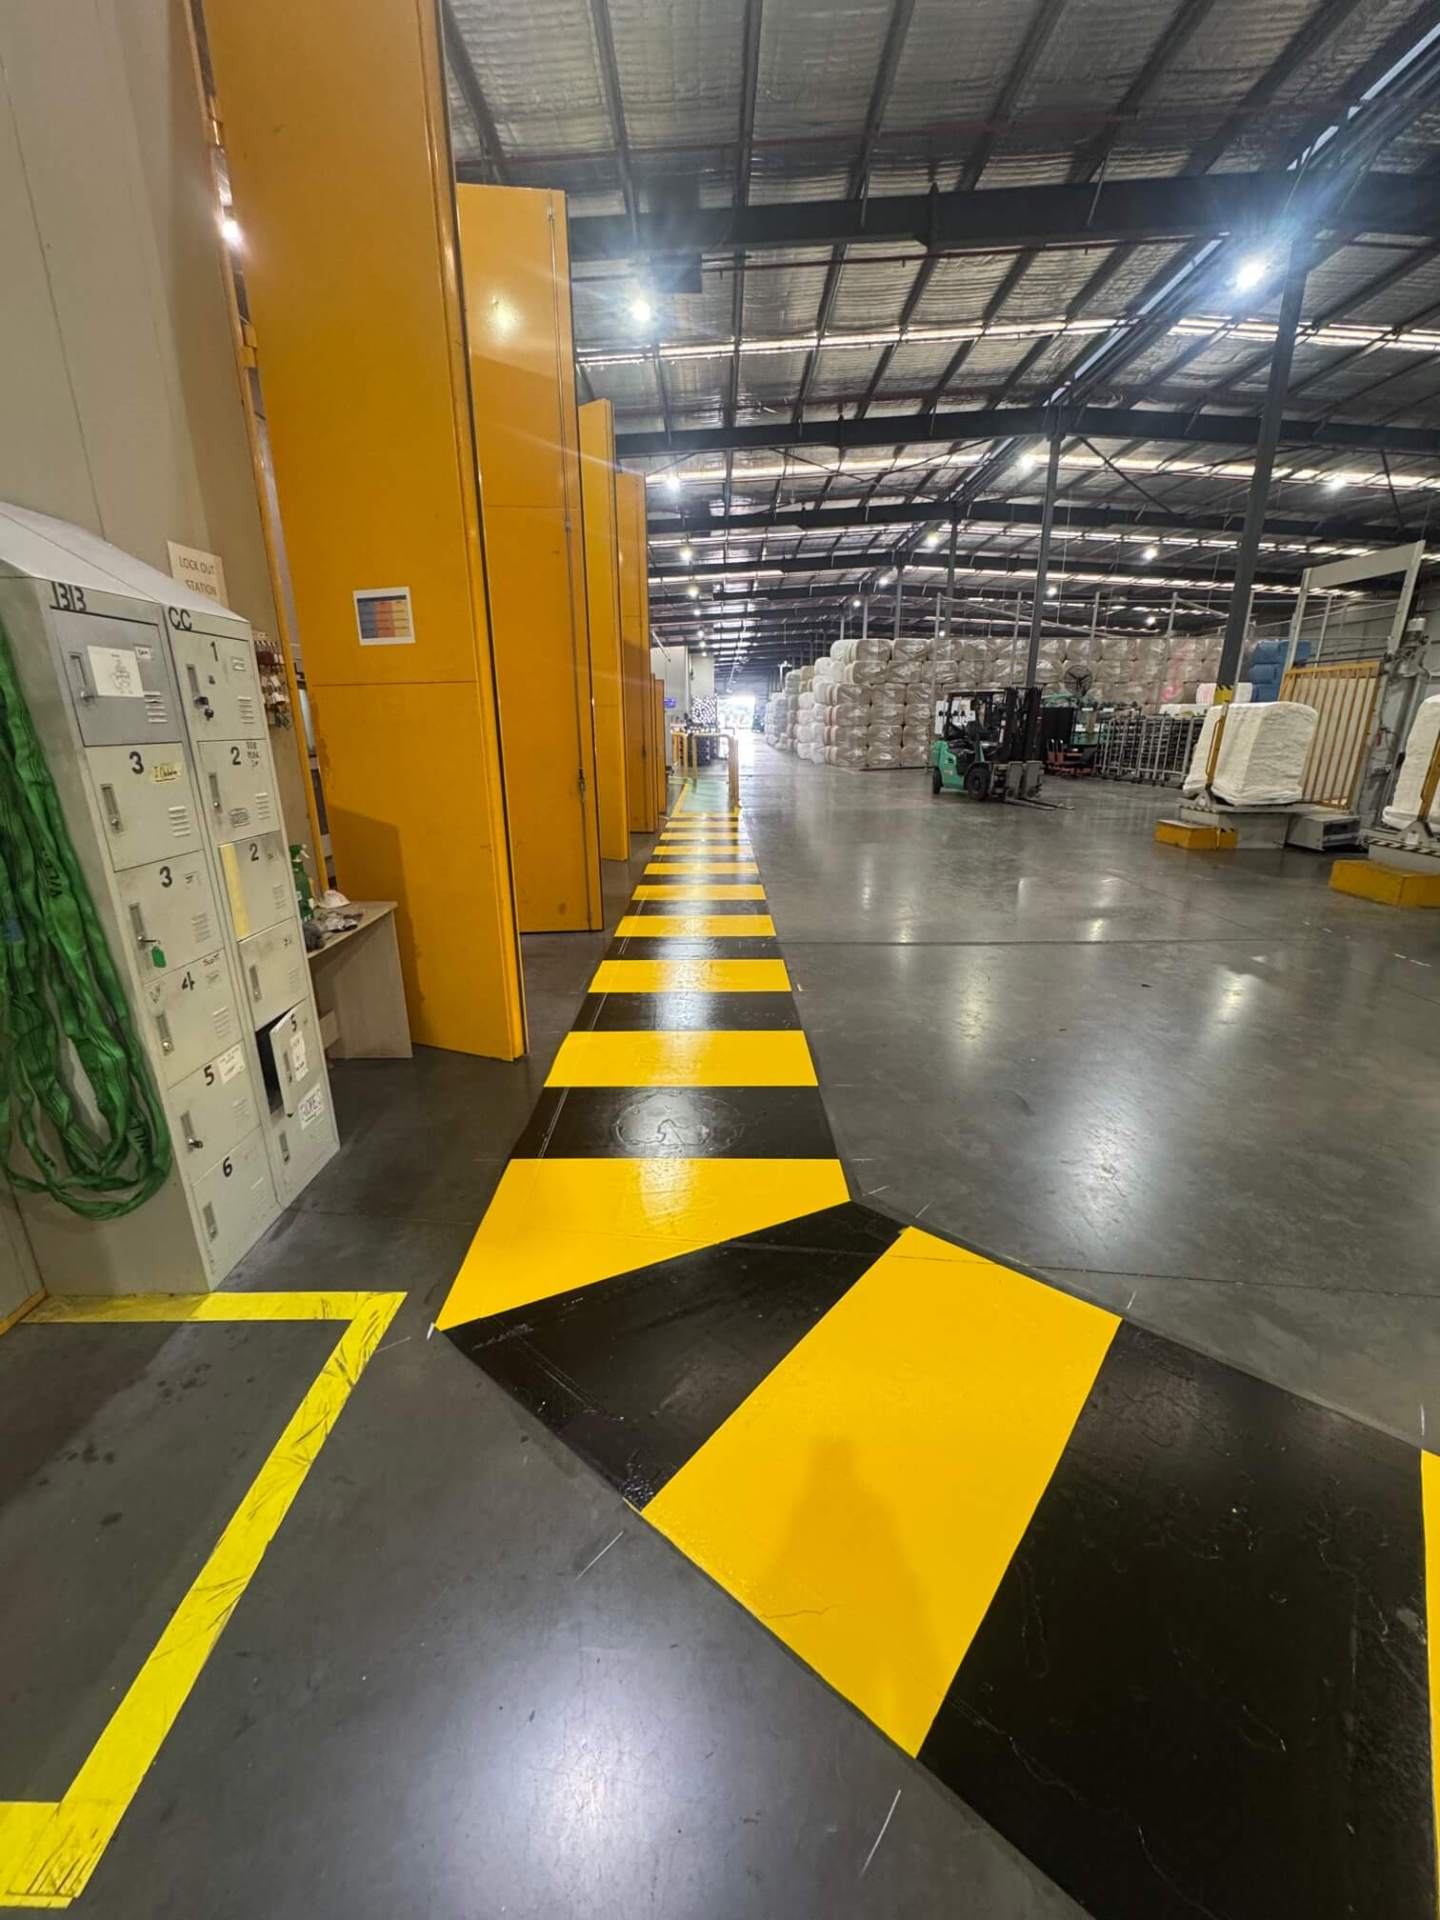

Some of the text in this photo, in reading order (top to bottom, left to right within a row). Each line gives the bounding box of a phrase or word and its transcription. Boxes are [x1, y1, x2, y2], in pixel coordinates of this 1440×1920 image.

[178, 555, 215, 575] LOCK OUT
[50, 581, 87, 611] BB
[185, 579, 217, 597] STATION
[168, 606, 193, 631] CC
[210, 641, 219, 662] 1
[129, 751, 144, 775] 3
[230, 746, 242, 766] 2
[249, 843, 260, 862] 2
[160, 866, 173, 888] 3
[181, 971, 196, 991] 4
[290, 1013, 298, 1033] 5
[203, 1064, 215, 1086] 5
[222, 1156, 233, 1178] 6
